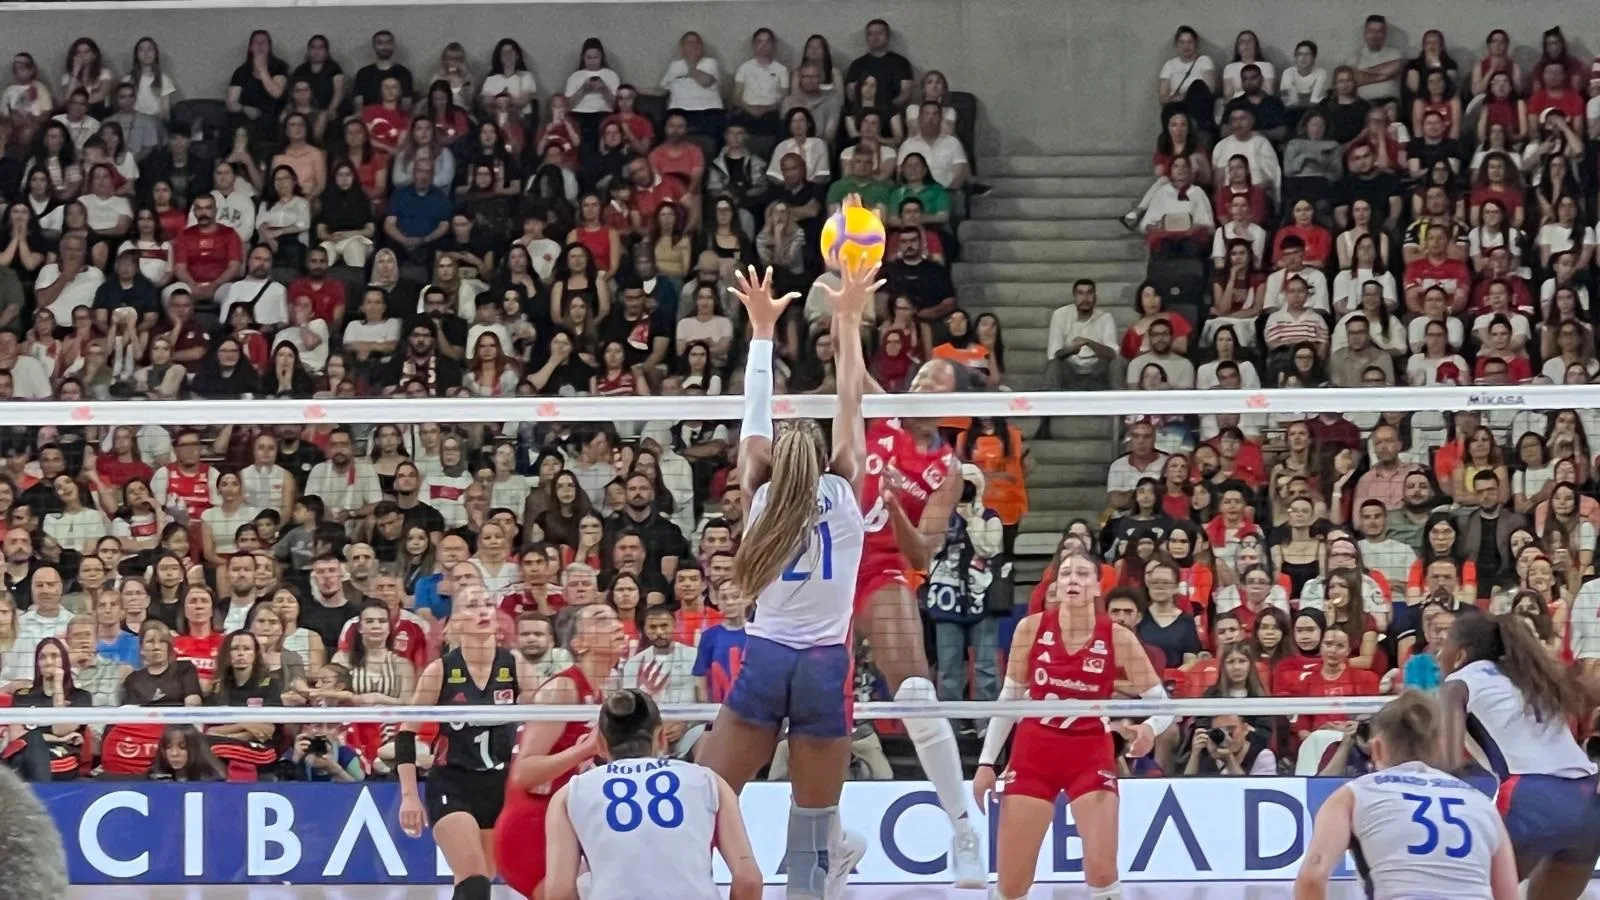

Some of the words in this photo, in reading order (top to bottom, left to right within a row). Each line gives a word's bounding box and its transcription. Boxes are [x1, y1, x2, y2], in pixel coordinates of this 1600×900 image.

[78, 785, 454, 877] CIBA
[602, 770, 684, 832] 88
[1401, 792, 1472, 858] 35
